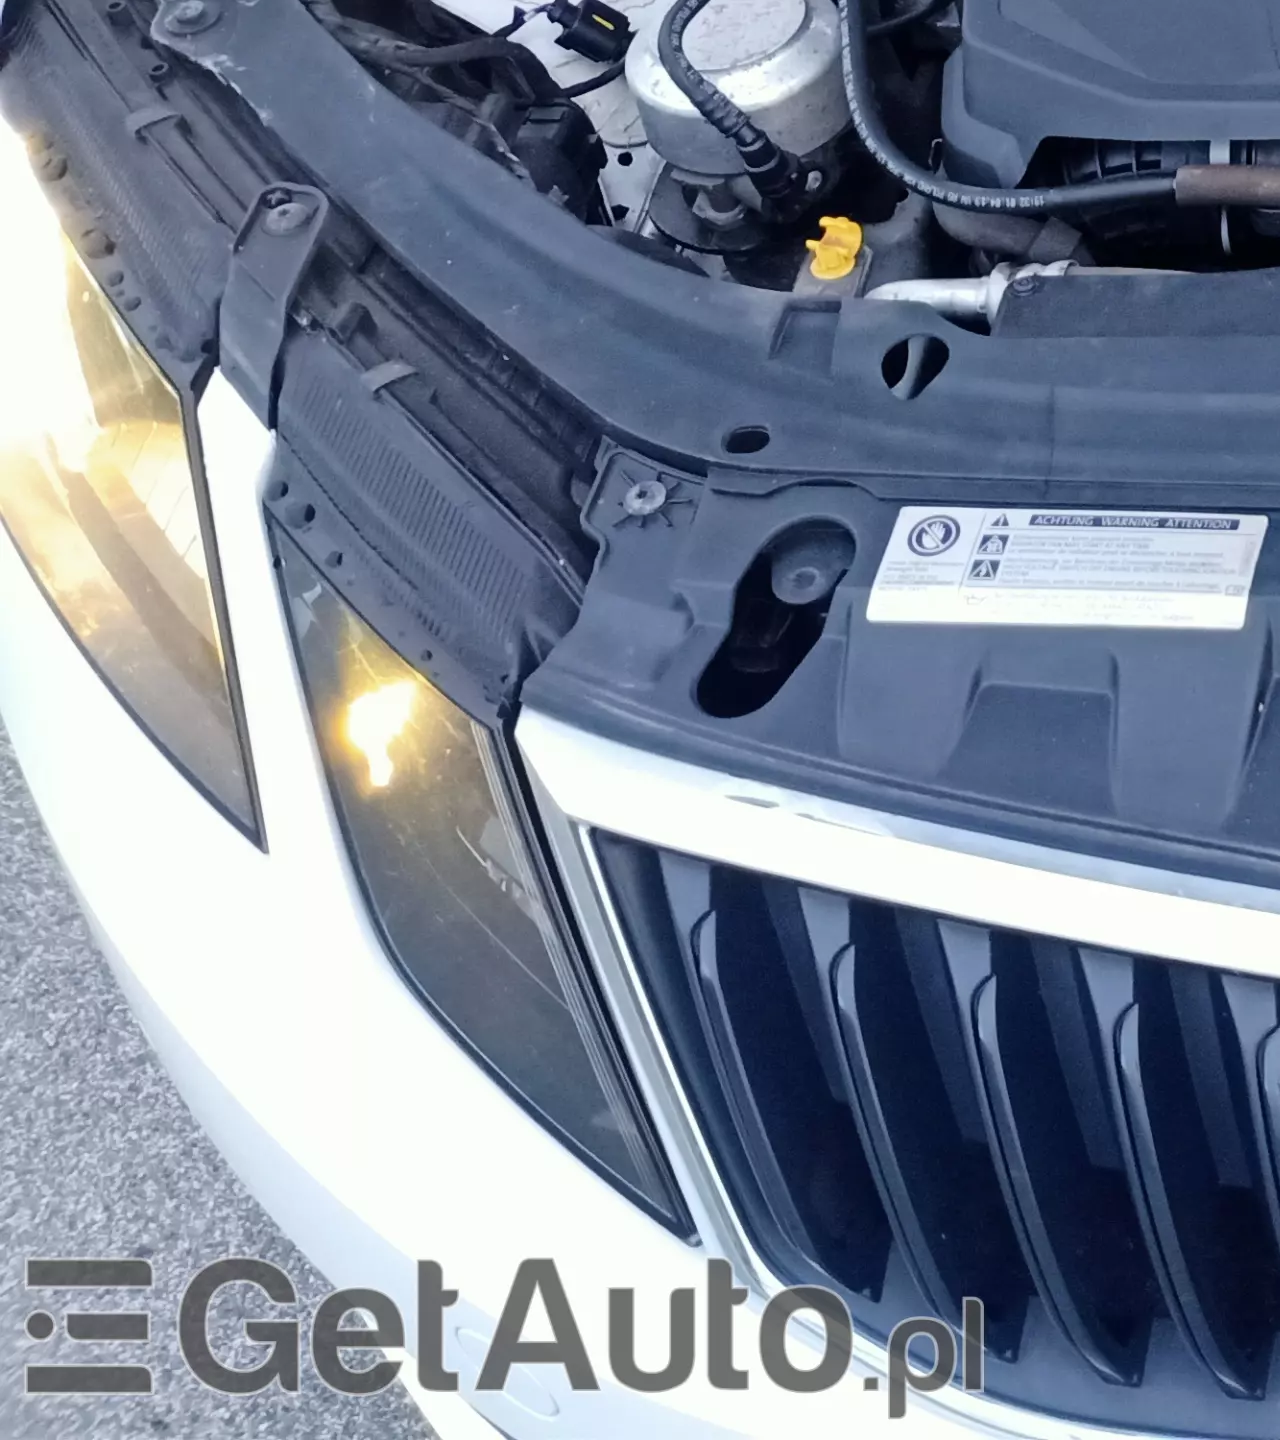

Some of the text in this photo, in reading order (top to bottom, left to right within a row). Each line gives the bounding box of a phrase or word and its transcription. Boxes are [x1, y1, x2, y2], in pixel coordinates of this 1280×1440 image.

[1034, 515, 1232, 530] ACHTUNG WARNING ATTENTION
